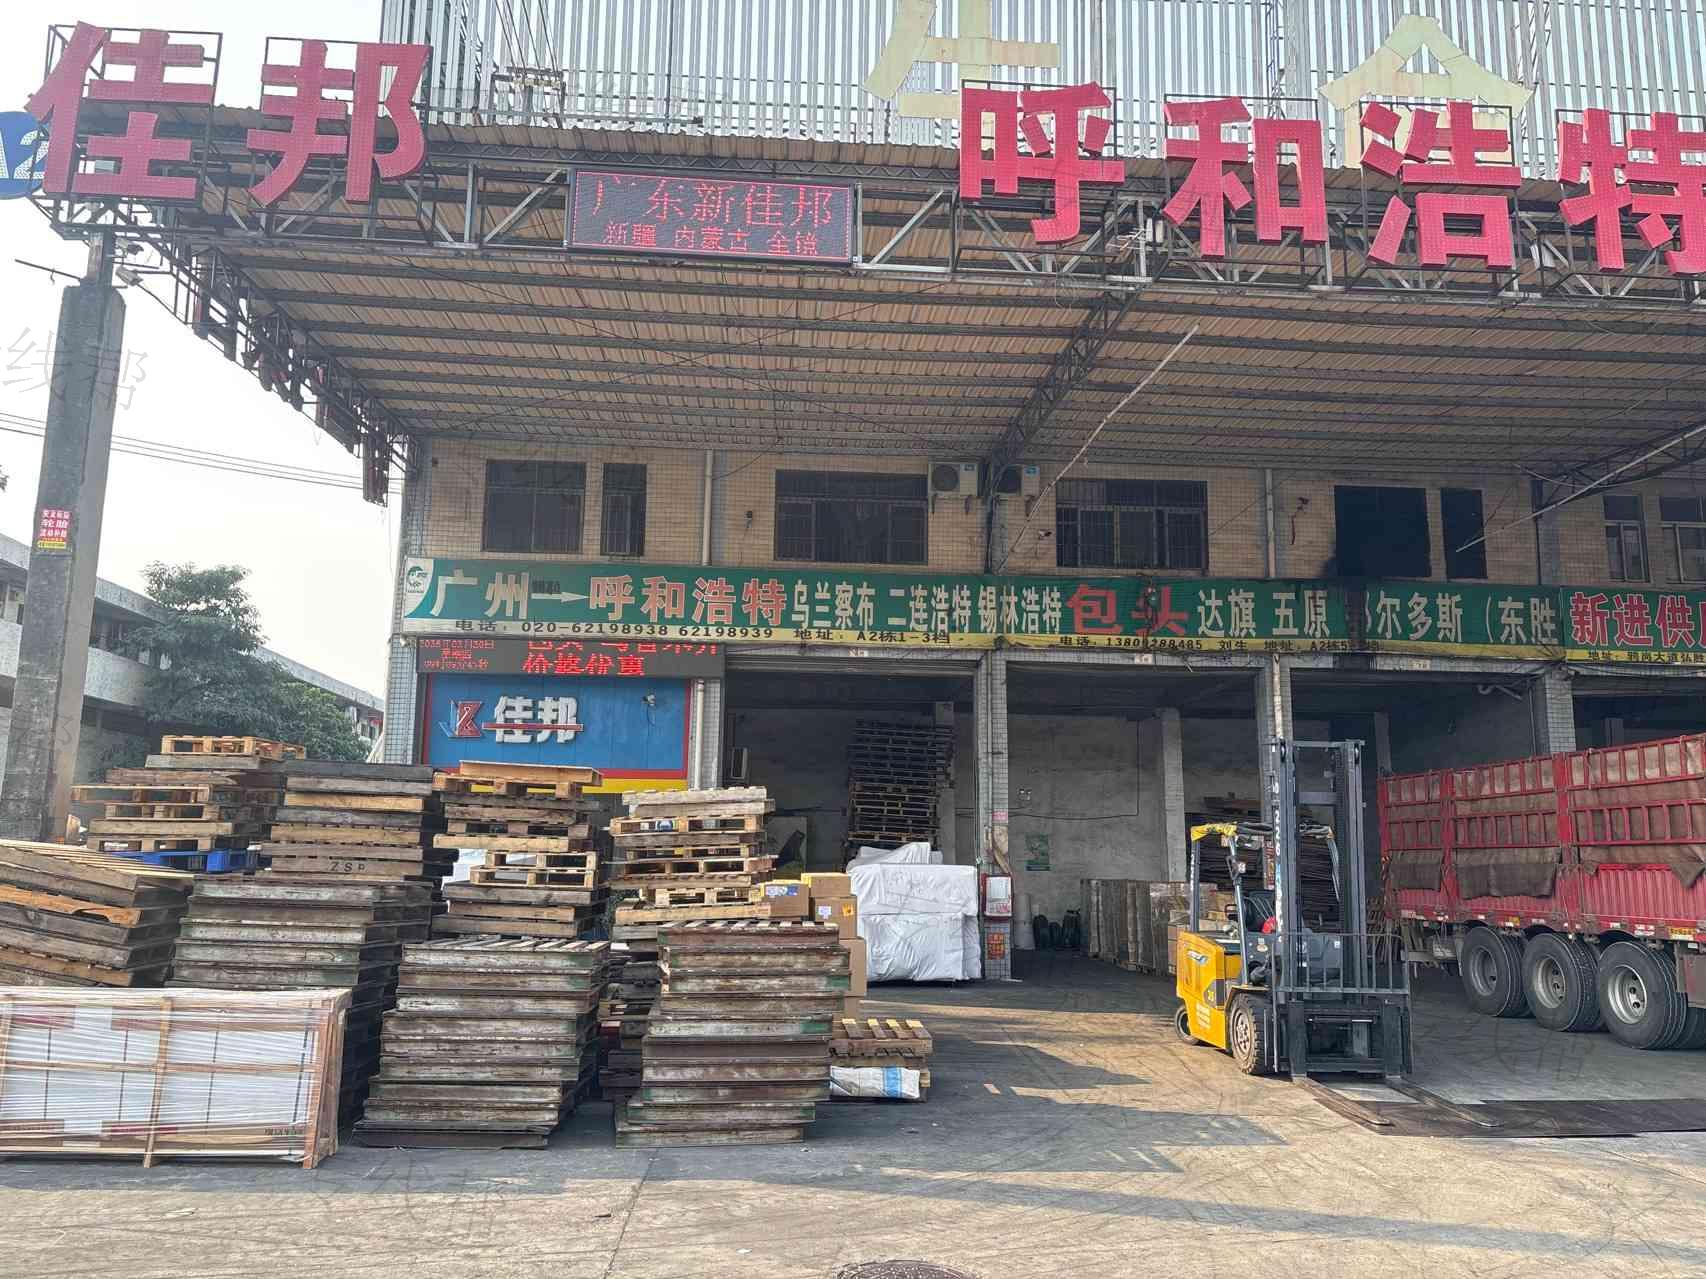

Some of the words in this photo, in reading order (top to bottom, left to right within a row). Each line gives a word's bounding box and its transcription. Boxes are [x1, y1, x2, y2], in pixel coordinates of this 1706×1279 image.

[24, 20, 433, 207] 佳邦
[592, 174, 833, 230] 广东新佳邦
[959, 82, 1706, 276] 呼和浩特
[674, 225, 749, 251] 内蒙古
[429, 568, 530, 620] 广州
[589, 574, 788, 627] 呼和浩特
[791, 578, 876, 631] 乌兰察布
[888, 583, 972, 633] 二连浩特
[978, 584, 1062, 634] 锡林浩特
[1066, 583, 1191, 636] 包头
[1197, 588, 1257, 638] 达旗
[1271, 589, 1331, 638] 五原
[1569, 591, 1706, 649] 新进供
[678, 626, 773, 639] 62198939
[494, 695, 579, 744] 佳邦
